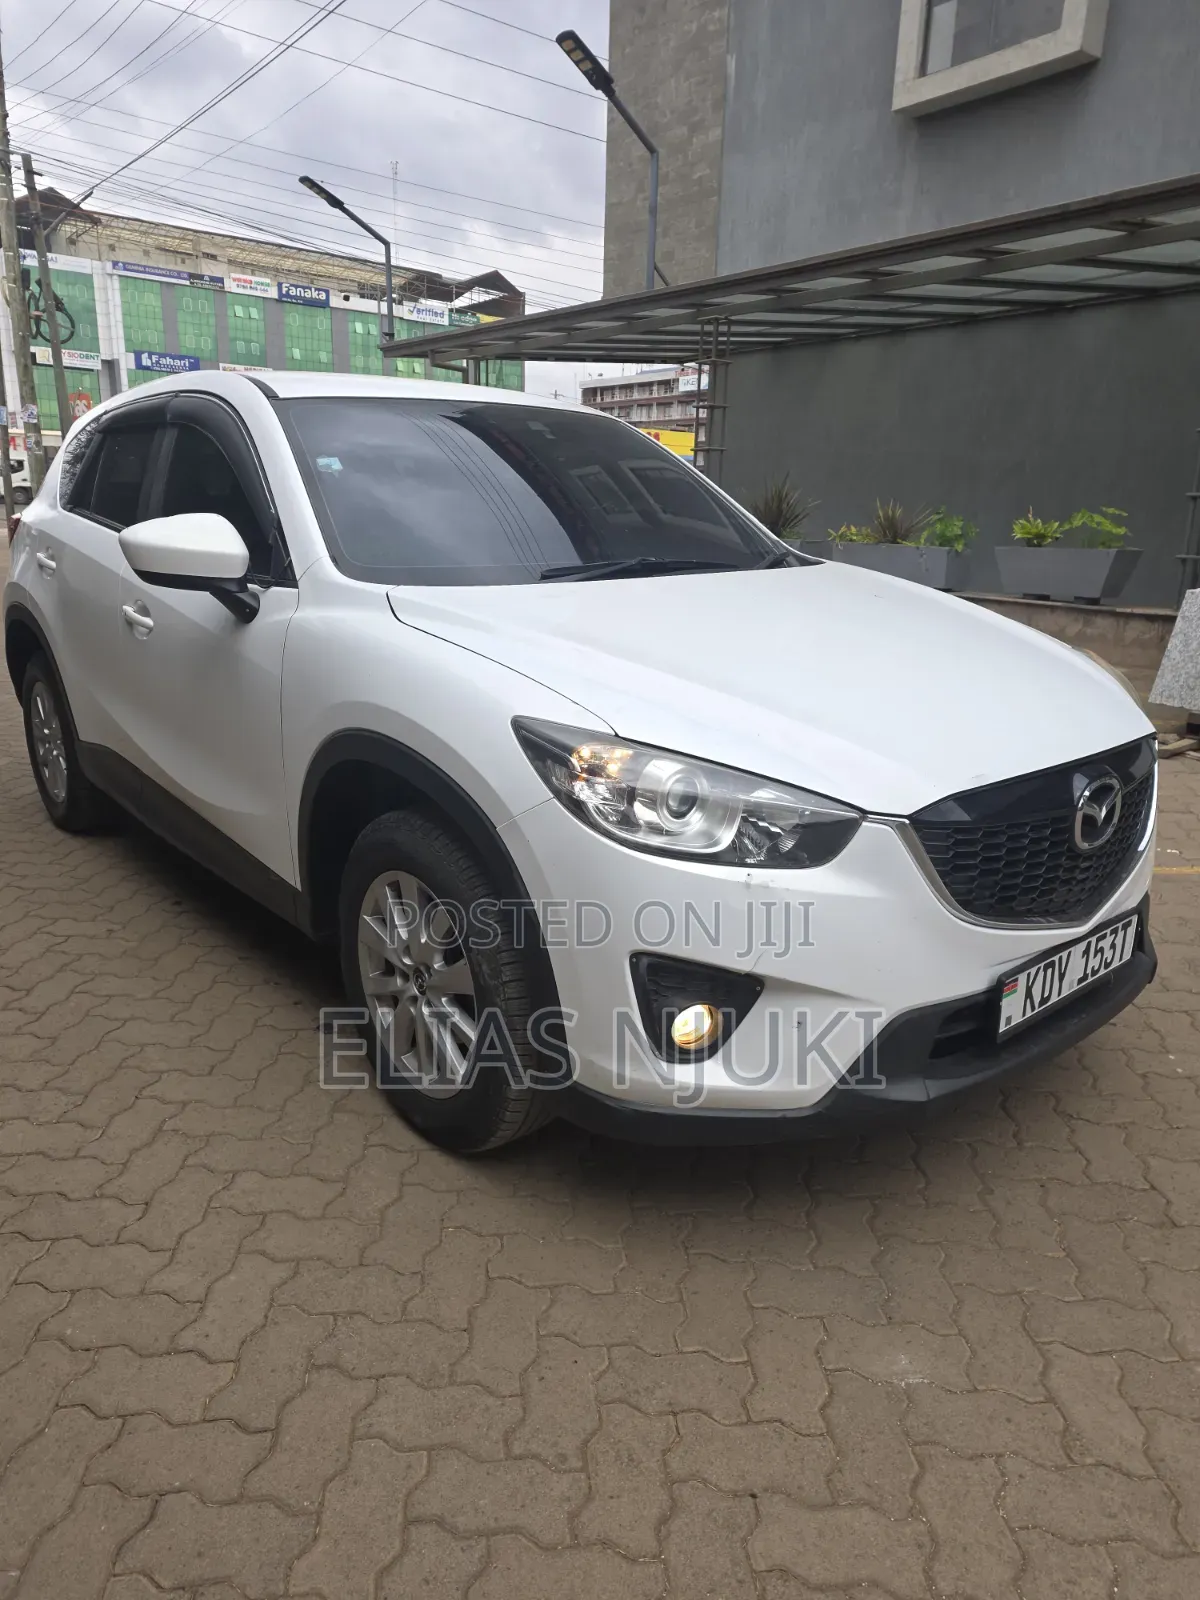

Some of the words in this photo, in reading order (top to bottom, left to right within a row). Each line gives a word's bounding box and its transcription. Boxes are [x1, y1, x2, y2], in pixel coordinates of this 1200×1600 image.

[282, 283, 326, 300] Fanaka
[61, 350, 100, 360] YSIODENT
[1022, 950, 1072, 1018] KDY
[1077, 918, 1133, 986] 153T
